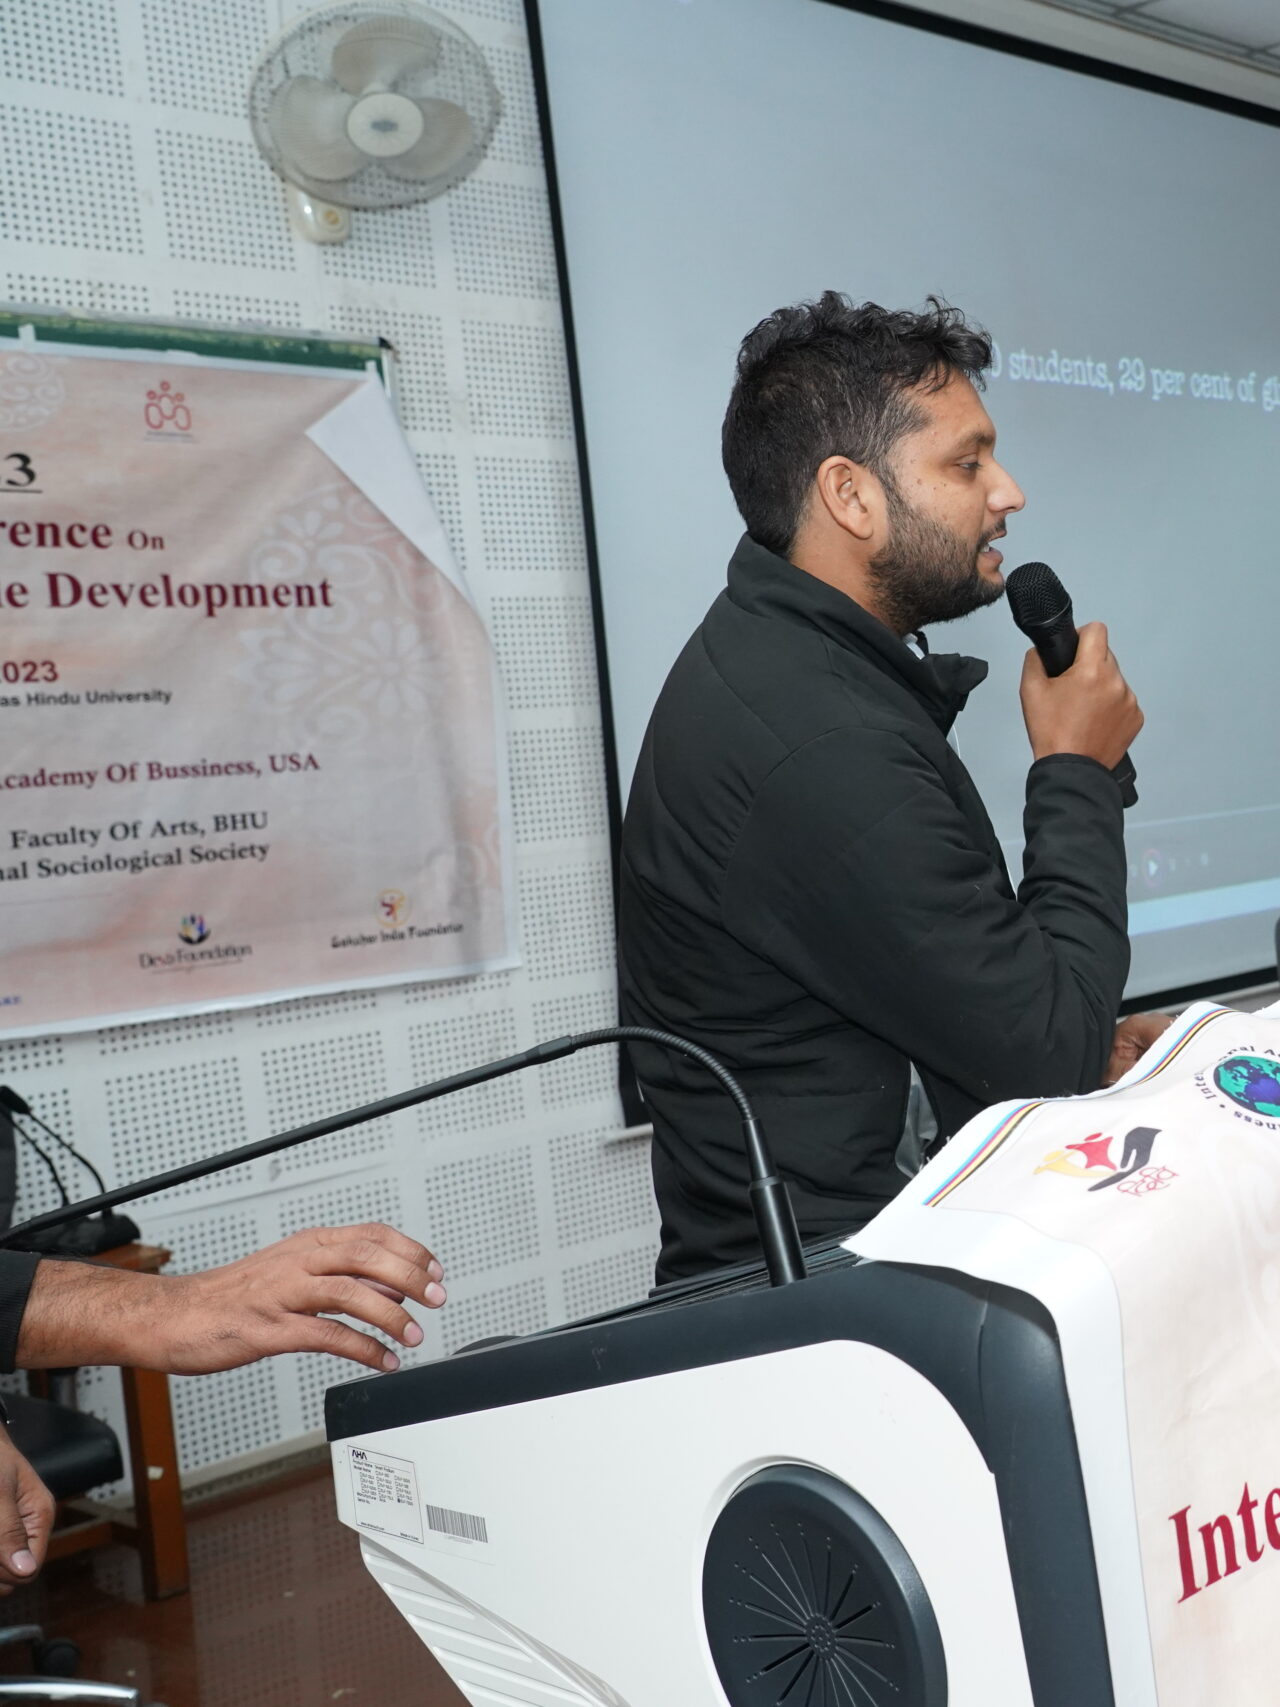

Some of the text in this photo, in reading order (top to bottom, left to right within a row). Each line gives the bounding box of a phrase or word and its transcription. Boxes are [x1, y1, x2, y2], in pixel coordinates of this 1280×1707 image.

[1009, 349, 1115, 395] students,
[1119, 357, 1146, 392] 29
[1151, 367, 1185, 400] per
[1191, 370, 1234, 401] cent
[1237, 371, 1258, 402] of
[128, 532, 164, 550] On
[44, 571, 333, 618] Development
[0, 660, 60, 683] 023
[26, 691, 80, 706] Hindu
[85, 686, 172, 706] University
[0, 754, 321, 790] cademy Of Bussiness, USA
[11, 811, 269, 849] Faculty Of Arts, BHU
[38, 847, 183, 879] Sociological
[188, 842, 270, 864] Society
